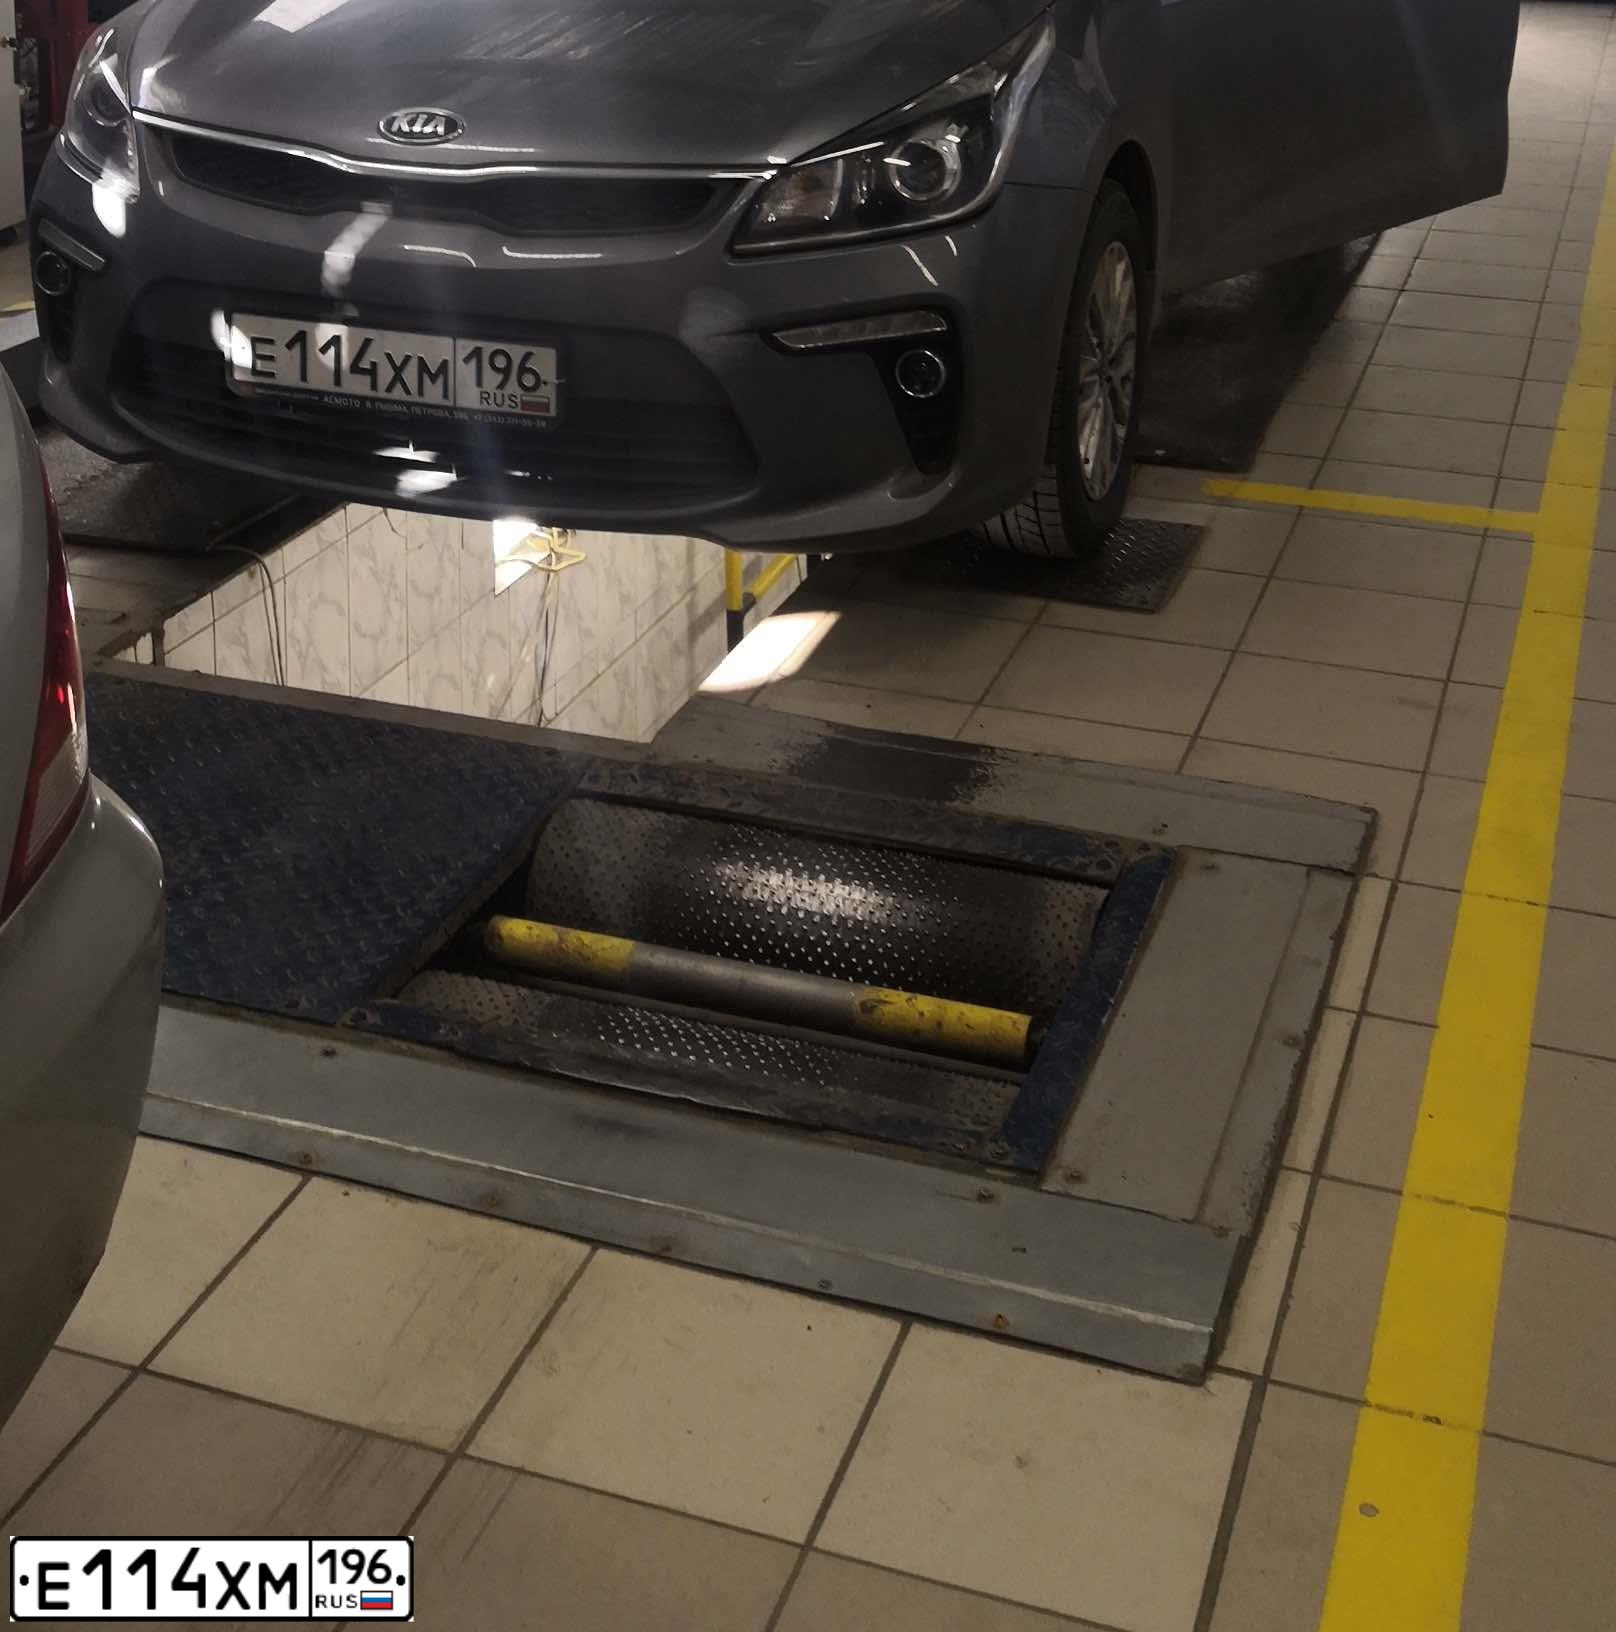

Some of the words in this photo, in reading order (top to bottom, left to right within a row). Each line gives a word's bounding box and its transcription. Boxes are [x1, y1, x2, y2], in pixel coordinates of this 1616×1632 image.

[391, 113, 446, 136] KIA
[462, 345, 543, 392] 196
[479, 389, 519, 410] RUS
